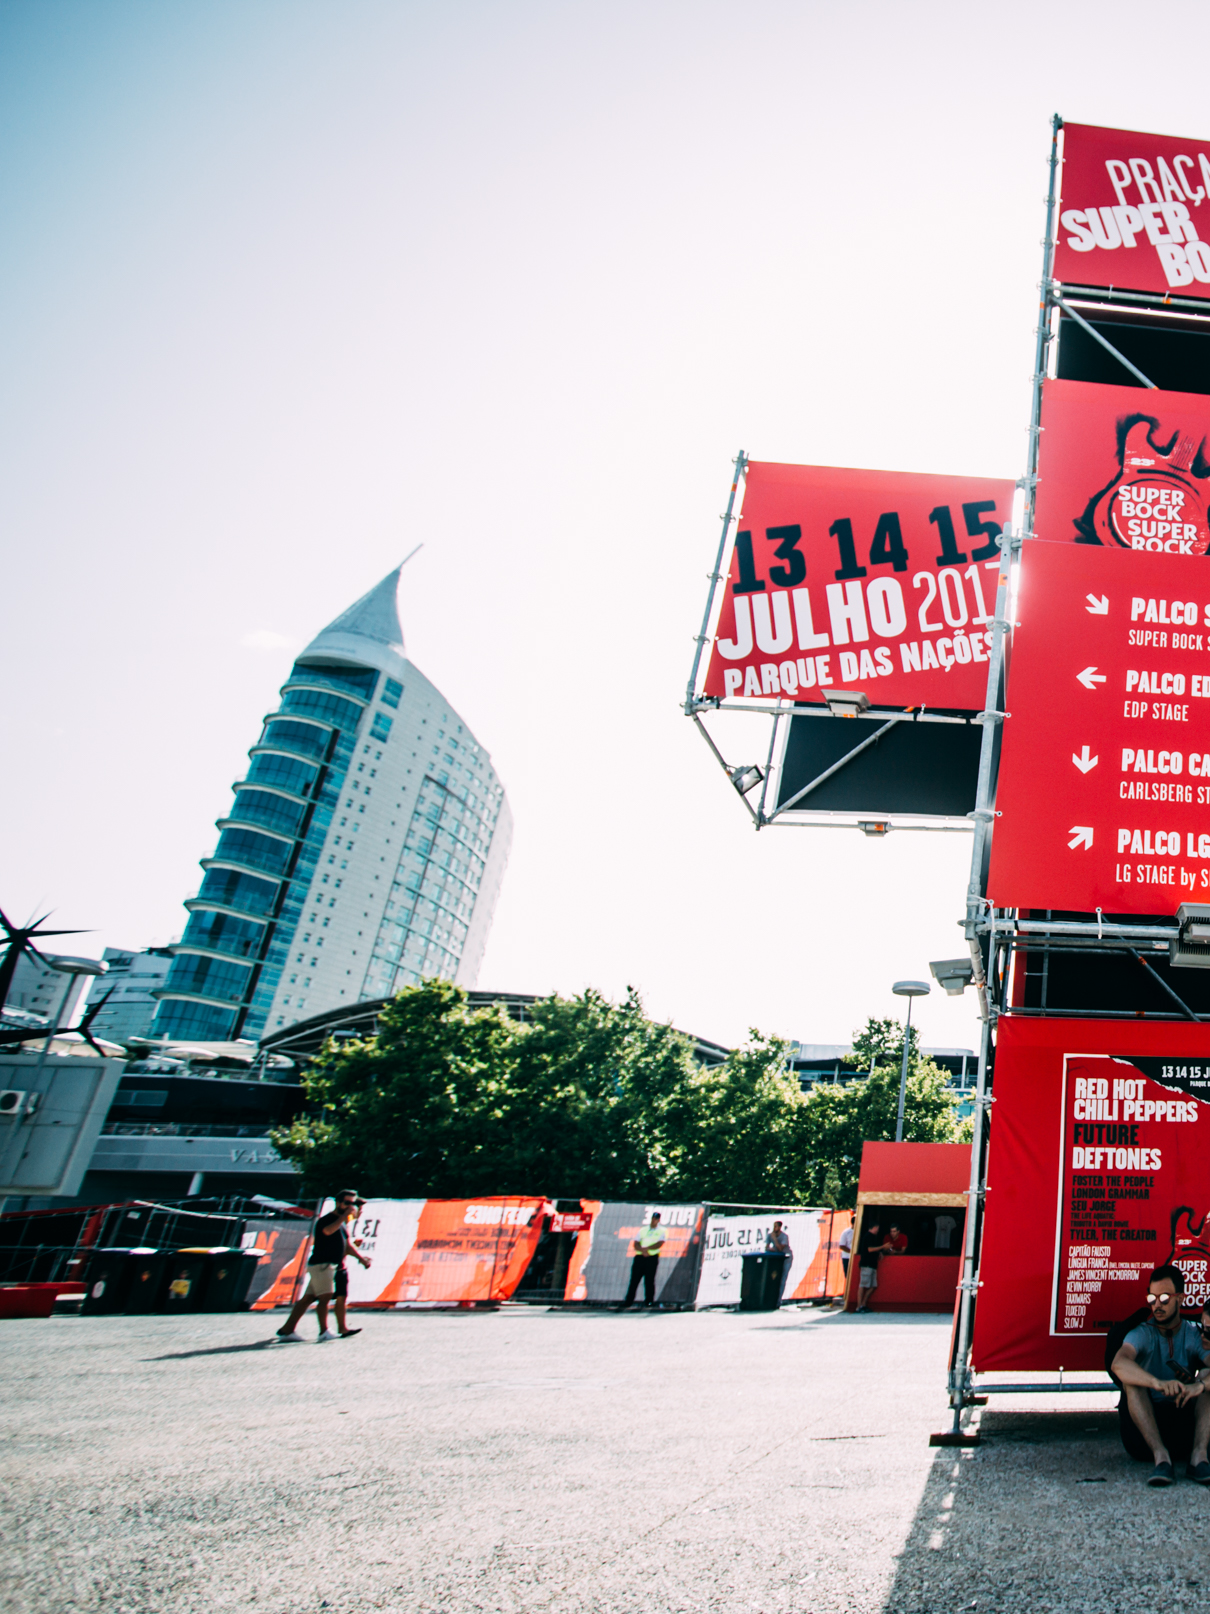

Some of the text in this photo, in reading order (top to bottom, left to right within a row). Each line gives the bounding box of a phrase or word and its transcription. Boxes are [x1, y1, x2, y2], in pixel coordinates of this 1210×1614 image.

[1060, 200, 1199, 252] SUPER
[1118, 485, 1185, 506] SUPER
[1121, 501, 1183, 521] BOCK
[1127, 519, 1198, 541] SUPER
[732, 500, 1003, 594] 13 14 15
[1131, 536, 1194, 555] ROCK
[717, 562, 1001, 660] JULHO 201
[1130, 597, 1198, 625] PALCO
[1128, 629, 1168, 648] SUPER
[1172, 632, 1203, 651] BOCK
[723, 655, 834, 698] PARQUE
[839, 646, 894, 682] DAS
[1125, 670, 1185, 695] PALCO
[1123, 700, 1189, 722] EDP STAGE
[1121, 748, 1183, 774] PALCO
[1119, 781, 1192, 803] CARLSBERG
[1117, 828, 1180, 856] PALCO
[1187, 832, 1210, 859] LG
[1115, 863, 1131, 883] LG
[1136, 864, 1176, 885] STAGE
[1180, 866, 1196, 891] by
[1161, 1065, 1174, 1078] 13
[1175, 1066, 1187, 1078] 14
[1189, 1066, 1201, 1079] 15
[1075, 1077, 1147, 1100] RED HOT
[1073, 1099, 1198, 1122] CHILI PEPPERS
[1073, 1123, 1140, 1145] FUTURE
[1072, 1146, 1162, 1170] DEFTONES
[1072, 1175, 1155, 1187] FOSTER THE PEOPLE
[1071, 1187, 1150, 1200] LONDON GRAMMAR
[1071, 1200, 1116, 1212] SEU JORGE
[1070, 1229, 1157, 1241] TYLER, THE CREATOR
[1068, 1244, 1111, 1257] CAPITÃO FAUSTO
[1068, 1256, 1087, 1269] LÍNGUA
[1088, 1258, 1109, 1269] FRANCA
[1171, 1260, 1208, 1271] SUPER
[1067, 1269, 1140, 1280] JAMES VINCENT MCMORROW
[1182, 1271, 1206, 1282] OCK
[1066, 1281, 1102, 1292] KEVIN MORBY
[1066, 1293, 1091, 1304] TAXIWARS
[1065, 1305, 1086, 1316] TUXEDO
[1064, 1317, 1079, 1328] SLOW
[1080, 1317, 1084, 1328] J
